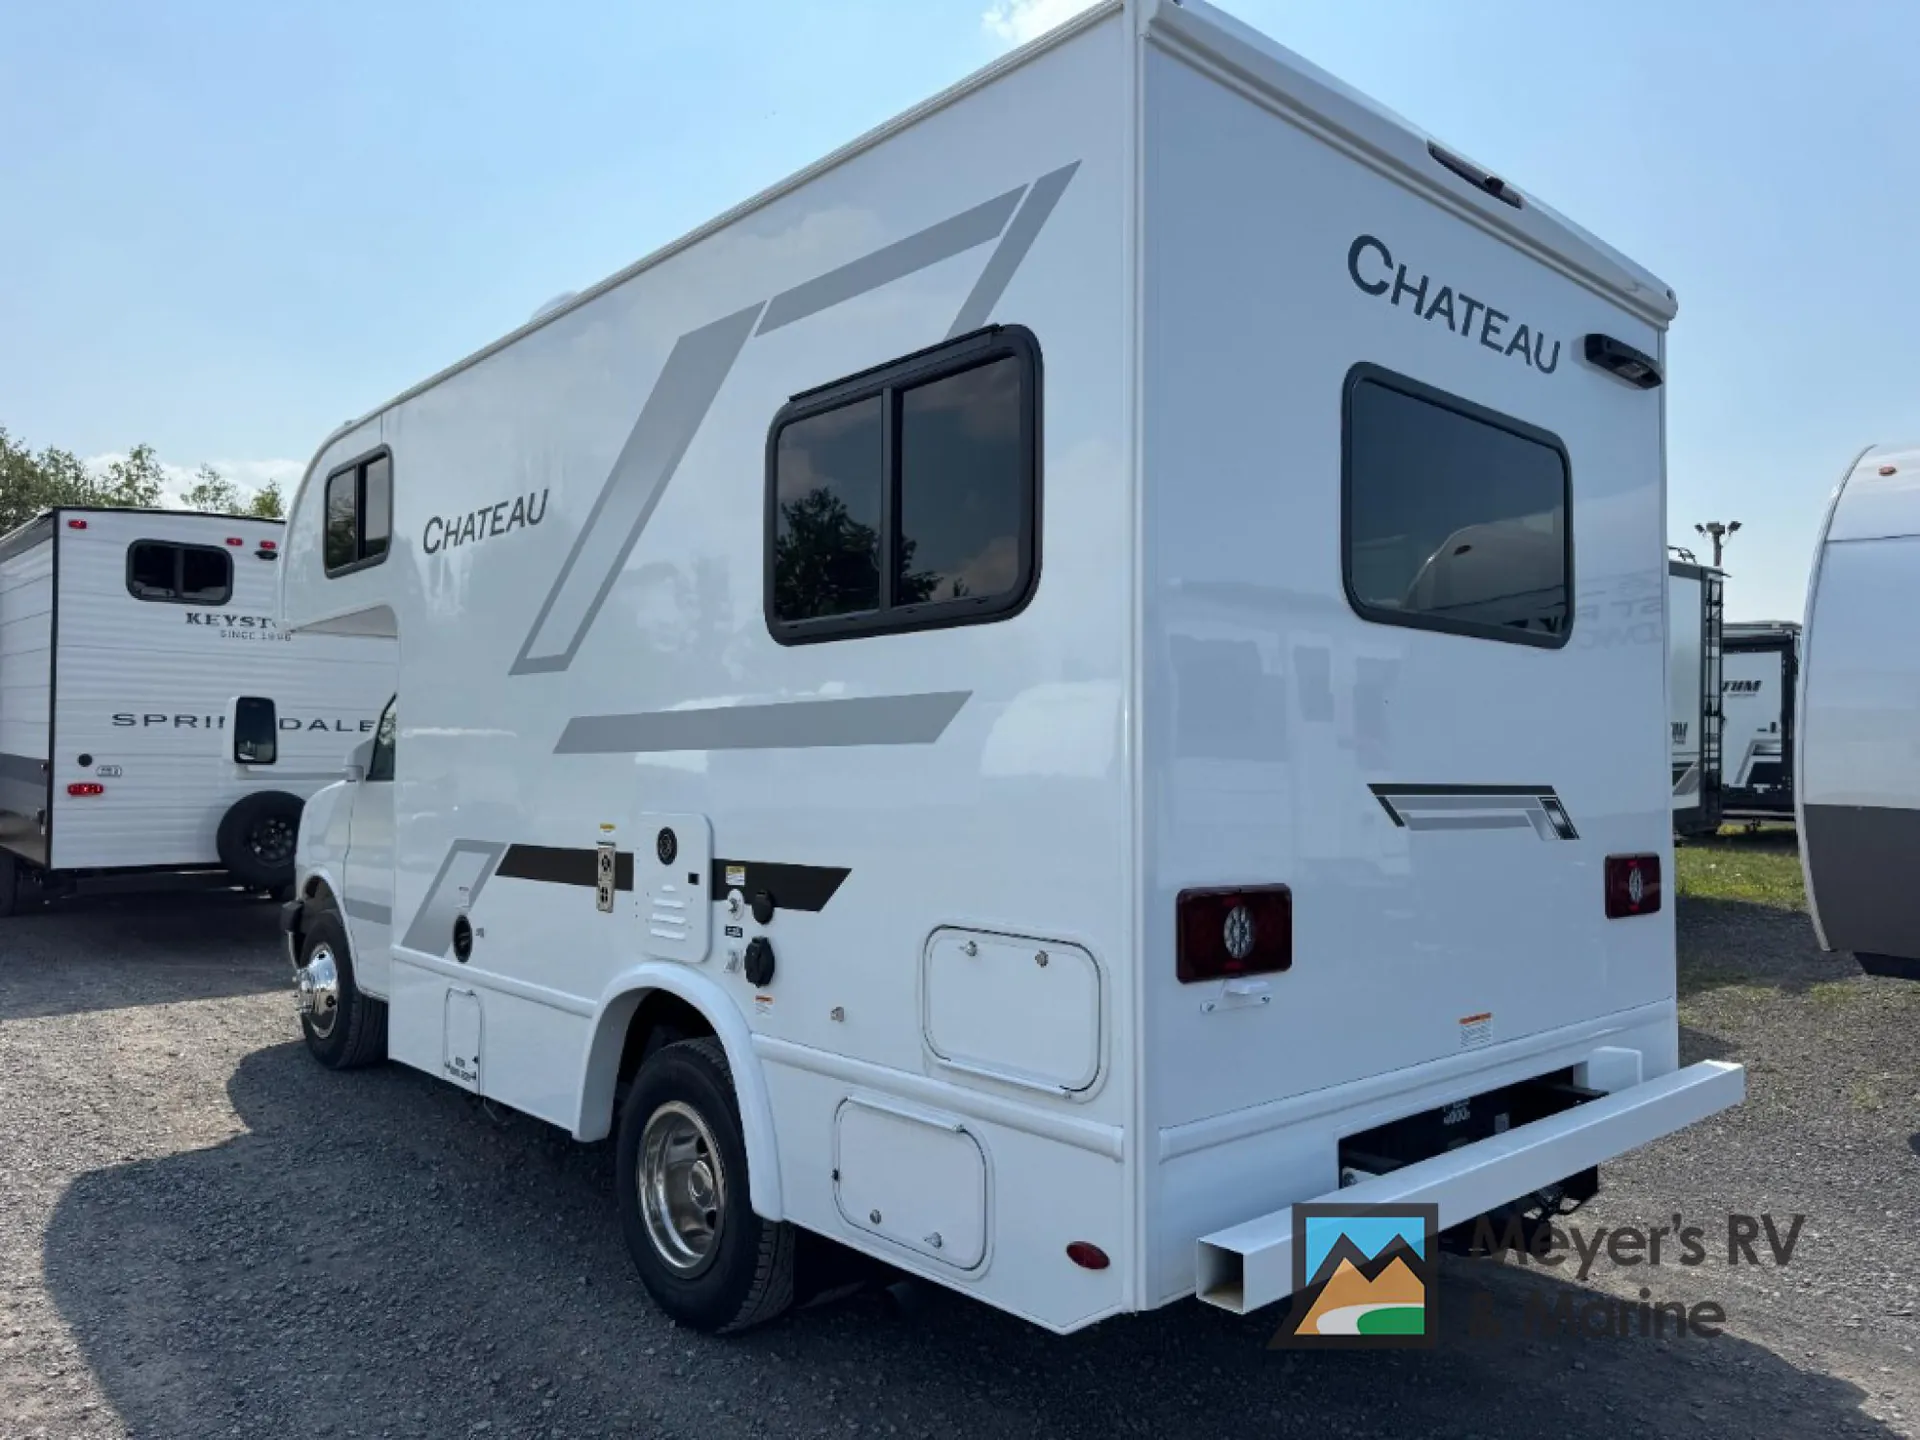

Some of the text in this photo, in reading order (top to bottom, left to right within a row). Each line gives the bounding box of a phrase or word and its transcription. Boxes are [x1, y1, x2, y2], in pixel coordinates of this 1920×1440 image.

[1347, 234, 1561, 375] CHATEAU
[423, 488, 549, 555] CHATEAU
[185, 612, 277, 629] KEYST
